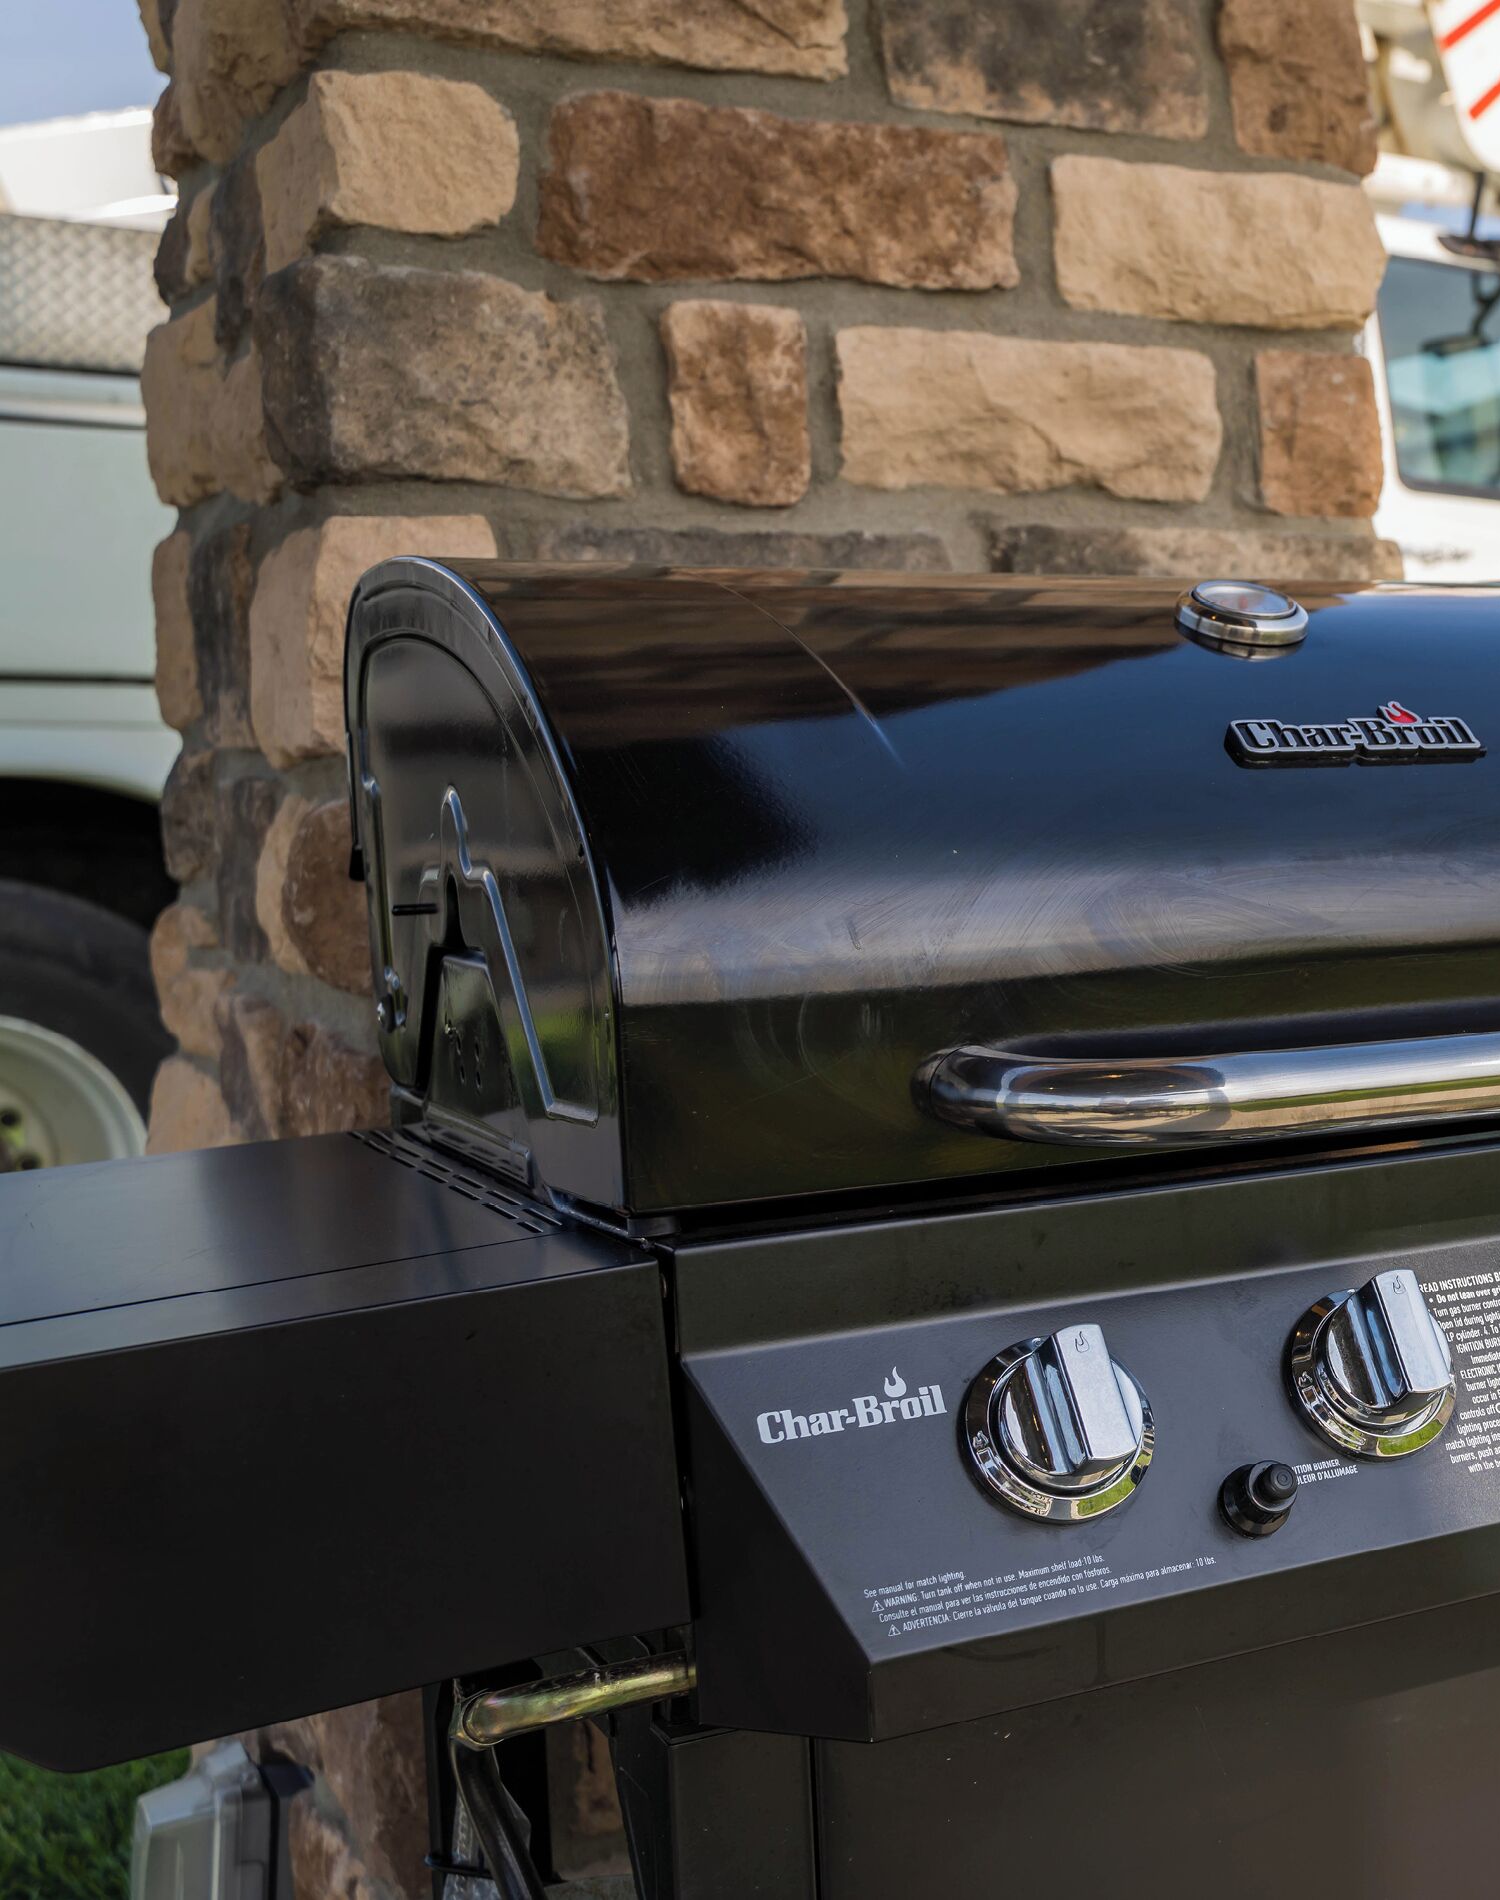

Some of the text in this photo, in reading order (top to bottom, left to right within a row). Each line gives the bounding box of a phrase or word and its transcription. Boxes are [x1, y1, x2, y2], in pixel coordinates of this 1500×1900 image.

[1232, 717, 1479, 750] Char-Broil
[1439, 1273, 1493, 1290] INSTRUCTIONS
[1436, 1294, 1446, 1303] Do
[1447, 1292, 1459, 1301] not
[1476, 1289, 1490, 1297] over
[756, 1384, 948, 1445] Char-Broil
[1313, 1459, 1340, 1471] BURNER
[1317, 1465, 1358, 1480] D'ALLUMAGE
[864, 1589, 877, 1598] See
[879, 1582, 904, 1594] manual
[905, 1581, 914, 1589] for
[916, 1576, 937, 1587] match
[920, 1591, 936, 1599] Turn
[937, 1586, 952, 1596] tank
[954, 1583, 963, 1593] off
[964, 1582, 982, 1590] when
[983, 1578, 994, 1586] not
[1018, 1567, 1050, 1579] Maximum
[1051, 1561, 1067, 1572] shelf
[953, 1610, 973, 1620] Cierre
[982, 1602, 1006, 1613] válvula
[1008, 1599, 1018, 1608] del
[1019, 1595, 1042, 1605] tanque
[1043, 1589, 1067, 1600] cuando
[1100, 1579, 1118, 1588] Carga
[1120, 1573, 1144, 1583] máxima
[1145, 1570, 1159, 1580] para
[1196, 1558, 1203, 1566] 10
[879, 1610, 909, 1622] Consulte
[911, 1607, 918, 1616] el
[919, 1601, 944, 1613] manual
[945, 1600, 960, 1610] para
[972, 1594, 983, 1602] las
[984, 1585, 1028, 1599] instrucciones
[1029, 1582, 1037, 1590] de
[1038, 1575, 1070, 1588] encendido
[1072, 1573, 1083, 1581] con
